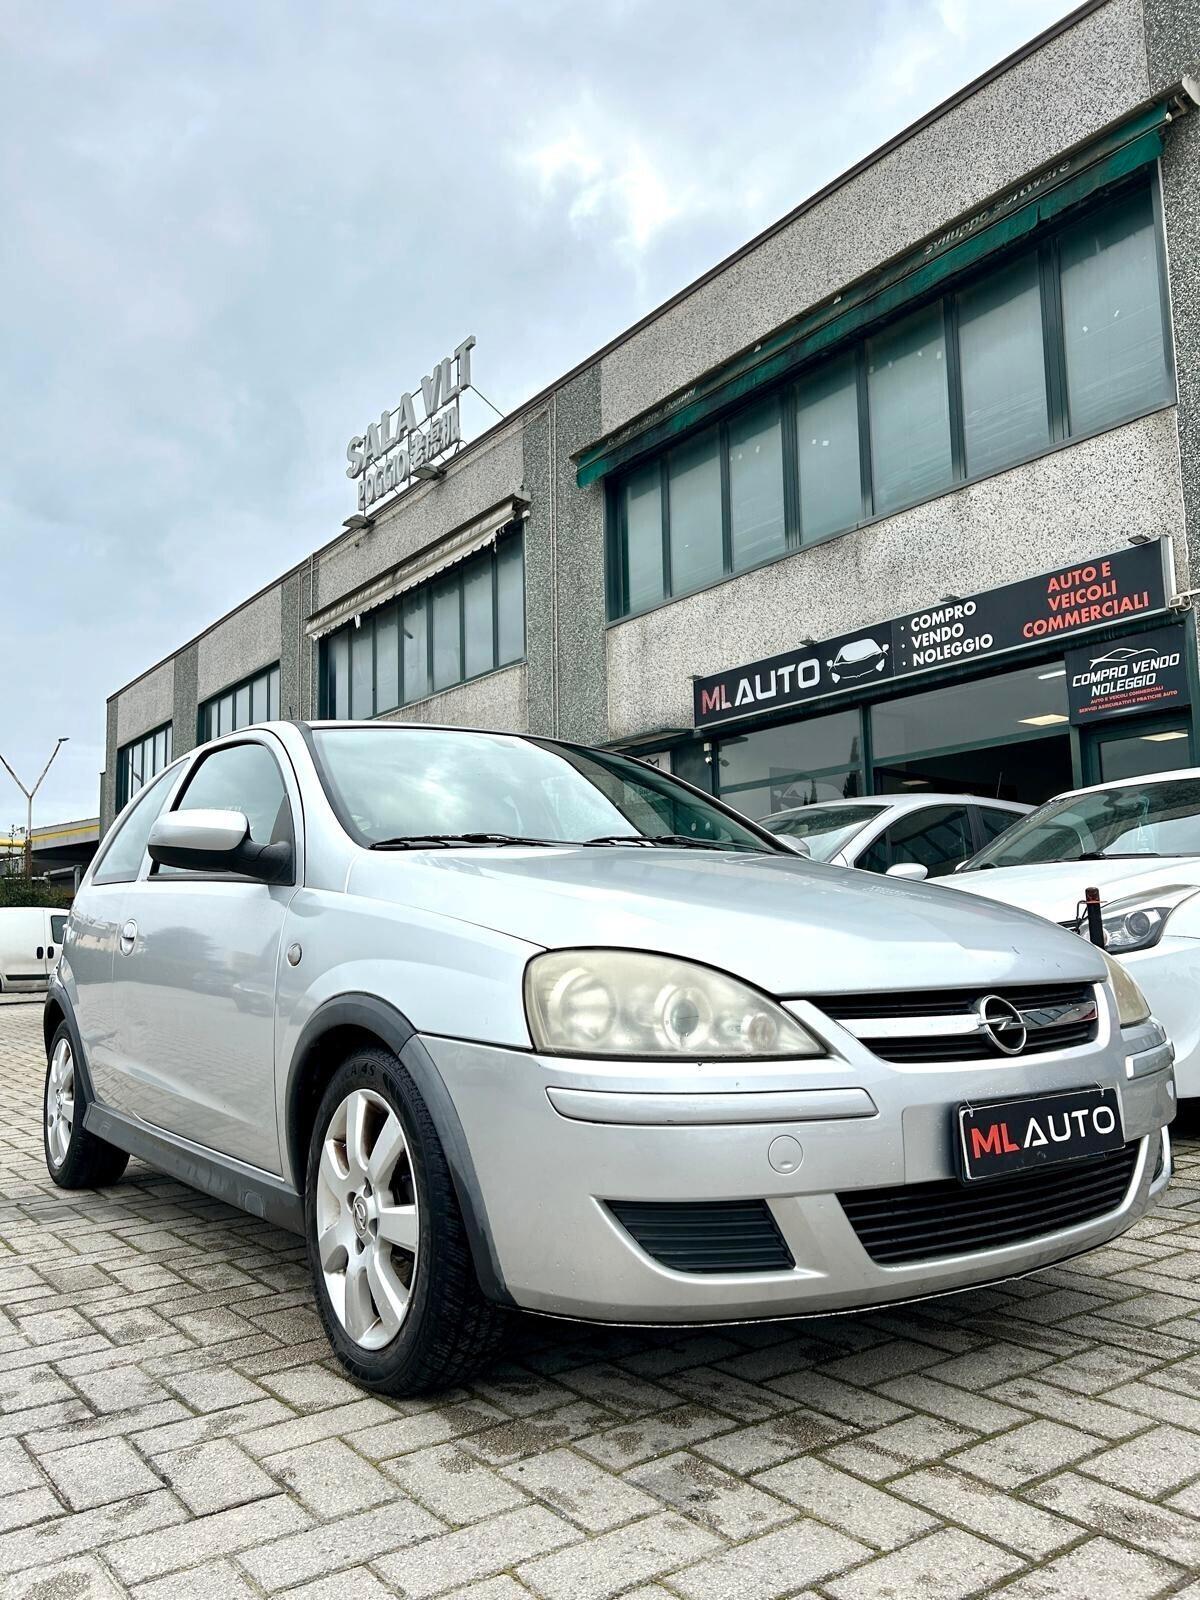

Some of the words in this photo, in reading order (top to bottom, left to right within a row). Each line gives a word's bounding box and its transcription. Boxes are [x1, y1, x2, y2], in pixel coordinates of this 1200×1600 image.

[346, 392, 417, 479] SALA
[420, 335, 476, 418] VLT
[358, 449, 410, 511] POGGIO
[1047, 566, 1097, 593] AUTO
[1102, 561, 1112, 577] E
[1047, 580, 1117, 611] VEICOLI
[910, 601, 977, 632] COMPRO
[1023, 591, 1149, 638] COMMERCIALI
[911, 623, 964, 649] VENDO
[912, 634, 994, 667] NOLEGGIO
[1072, 665, 1128, 687] COMPRO
[1132, 653, 1180, 674] VENDO
[1091, 673, 1156, 697] NOLEGGIO
[1163, 689, 1178, 698] AUTO
